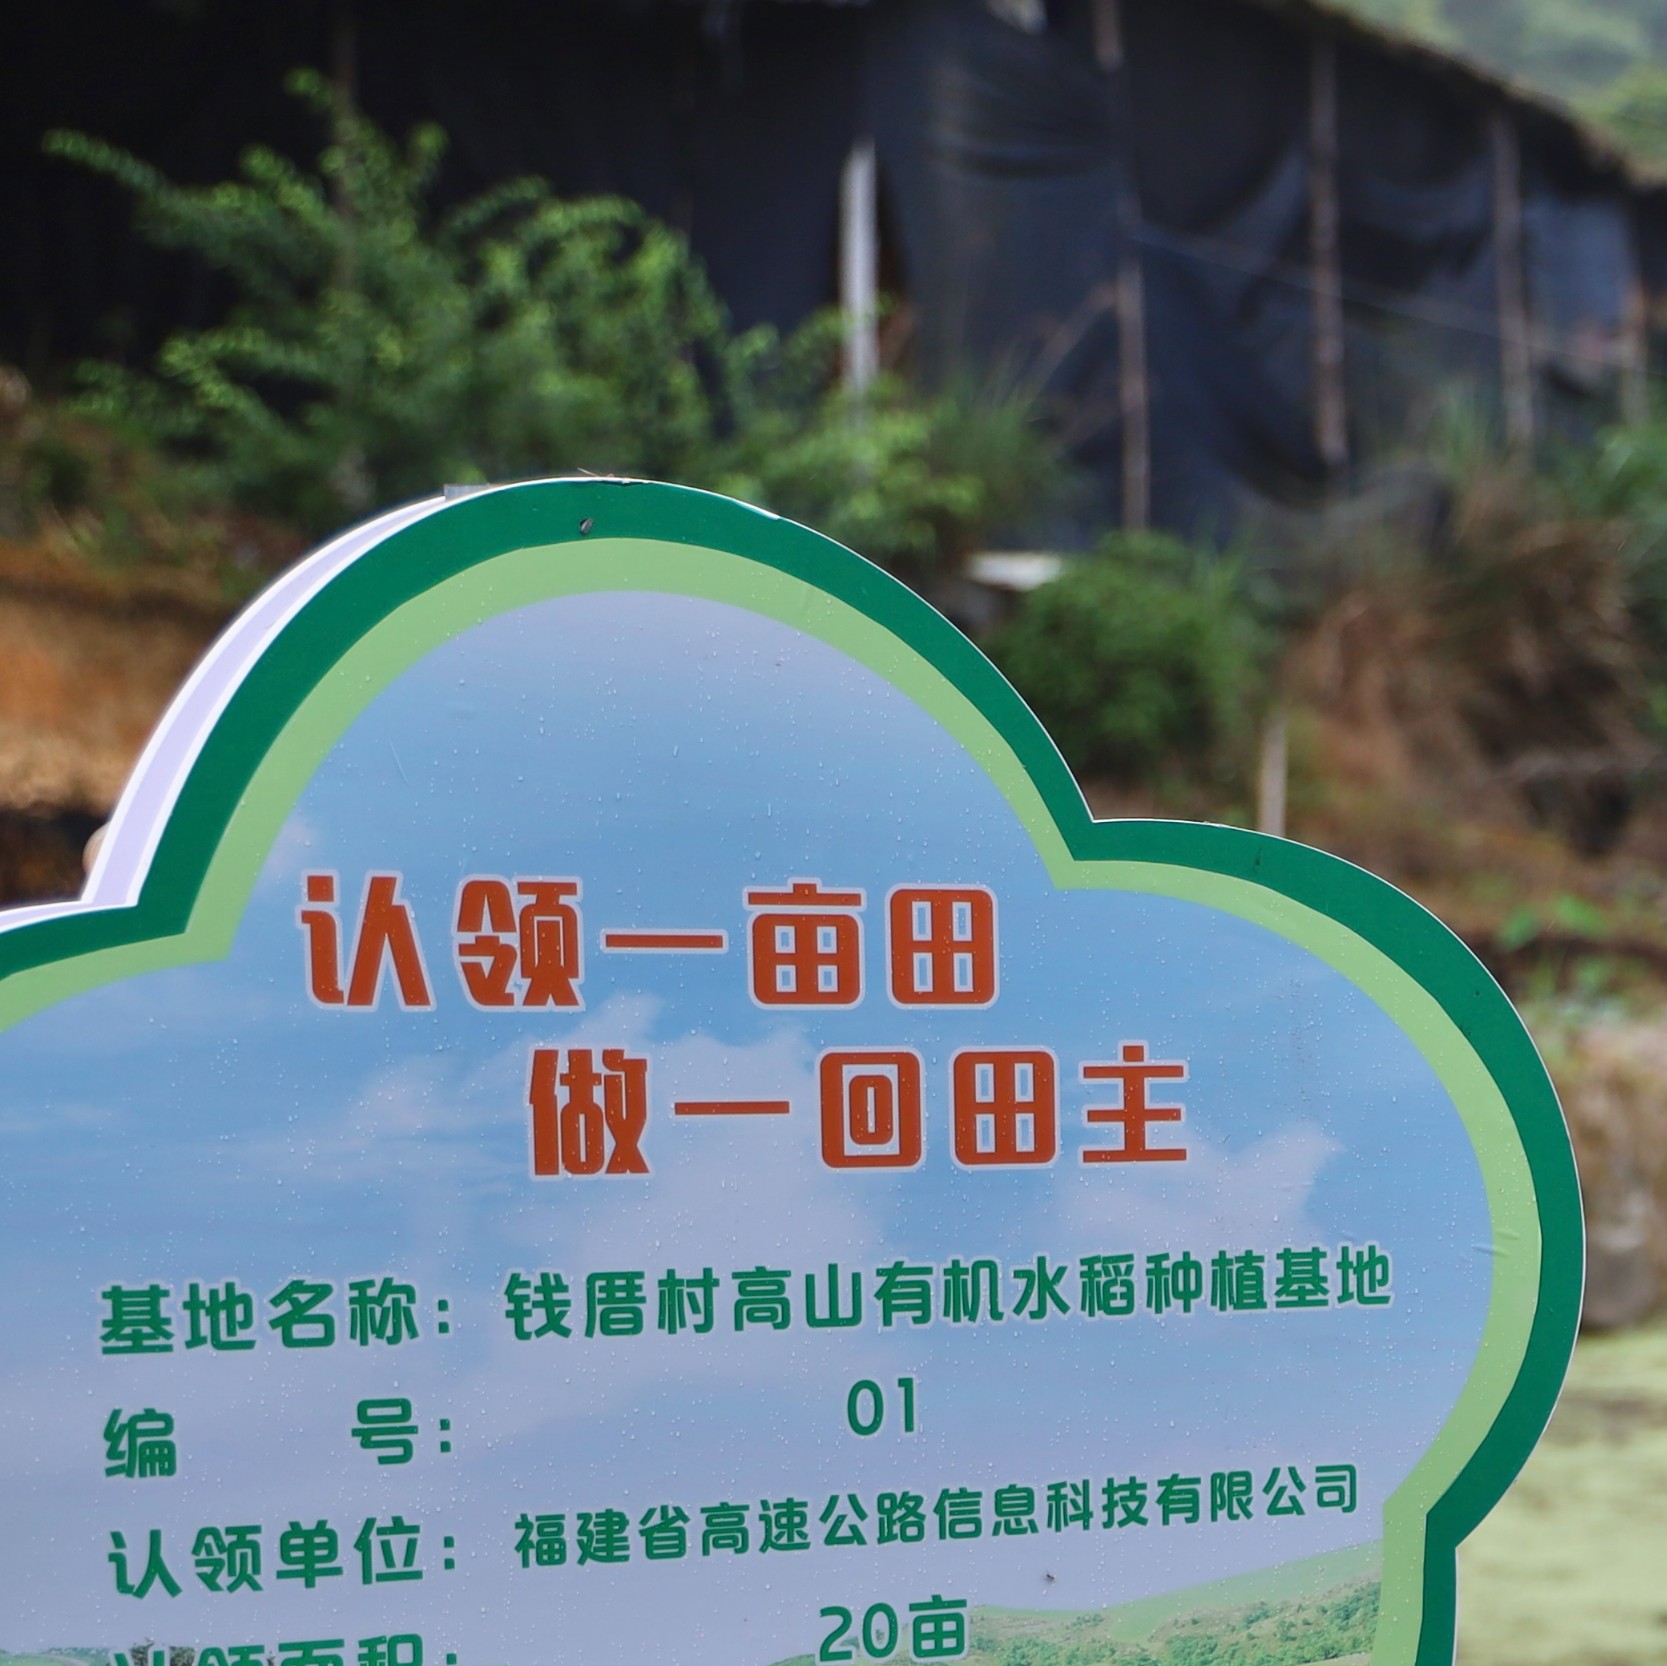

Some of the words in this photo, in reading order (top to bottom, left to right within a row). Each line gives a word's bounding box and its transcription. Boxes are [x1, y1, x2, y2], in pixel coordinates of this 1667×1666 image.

[301, 874, 999, 1008] 认领一亩田
[527, 1044, 1188, 1177] 做一回田主
[503, 1244, 1393, 1342] 钱厝村高山有机水稻种植基地
[846, 1376, 920, 1437] 01
[514, 1463, 1358, 1570] 福建省高速公路信息科技有限公司
[817, 1595, 970, 1666] 20亩
